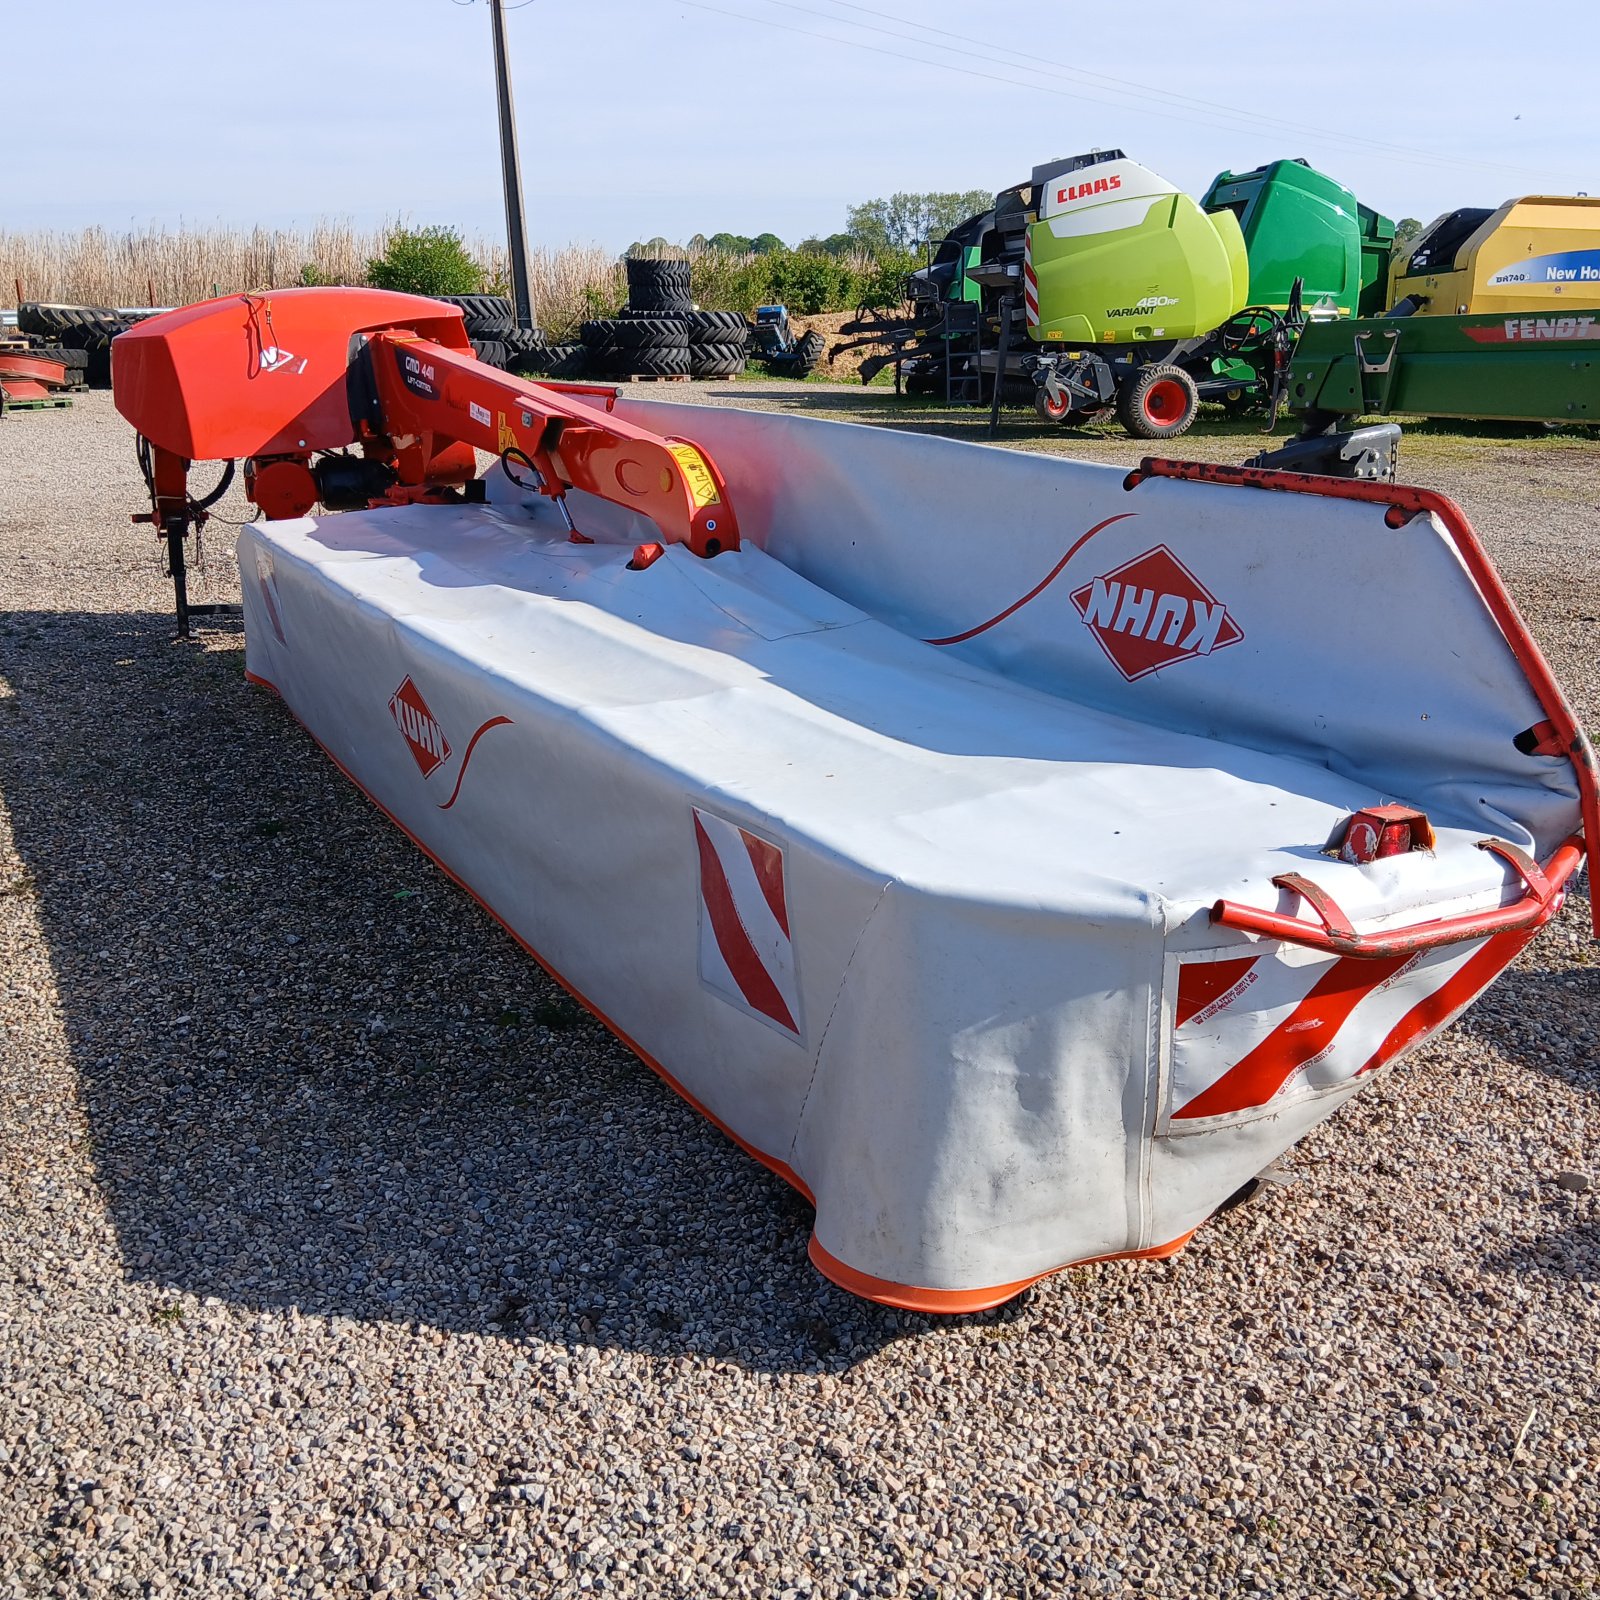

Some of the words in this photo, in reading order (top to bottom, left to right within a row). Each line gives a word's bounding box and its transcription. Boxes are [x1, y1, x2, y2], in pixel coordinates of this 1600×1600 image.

[1057, 174, 1122, 204] CLAAS
[1546, 266, 1577, 280] New
[1105, 305, 1157, 318] VARIANT
[1504, 316, 1596, 339] FENDT
[405, 355, 420, 375] GMD
[1082, 577, 1227, 656] KUHN
[392, 693, 446, 765] KUHN
